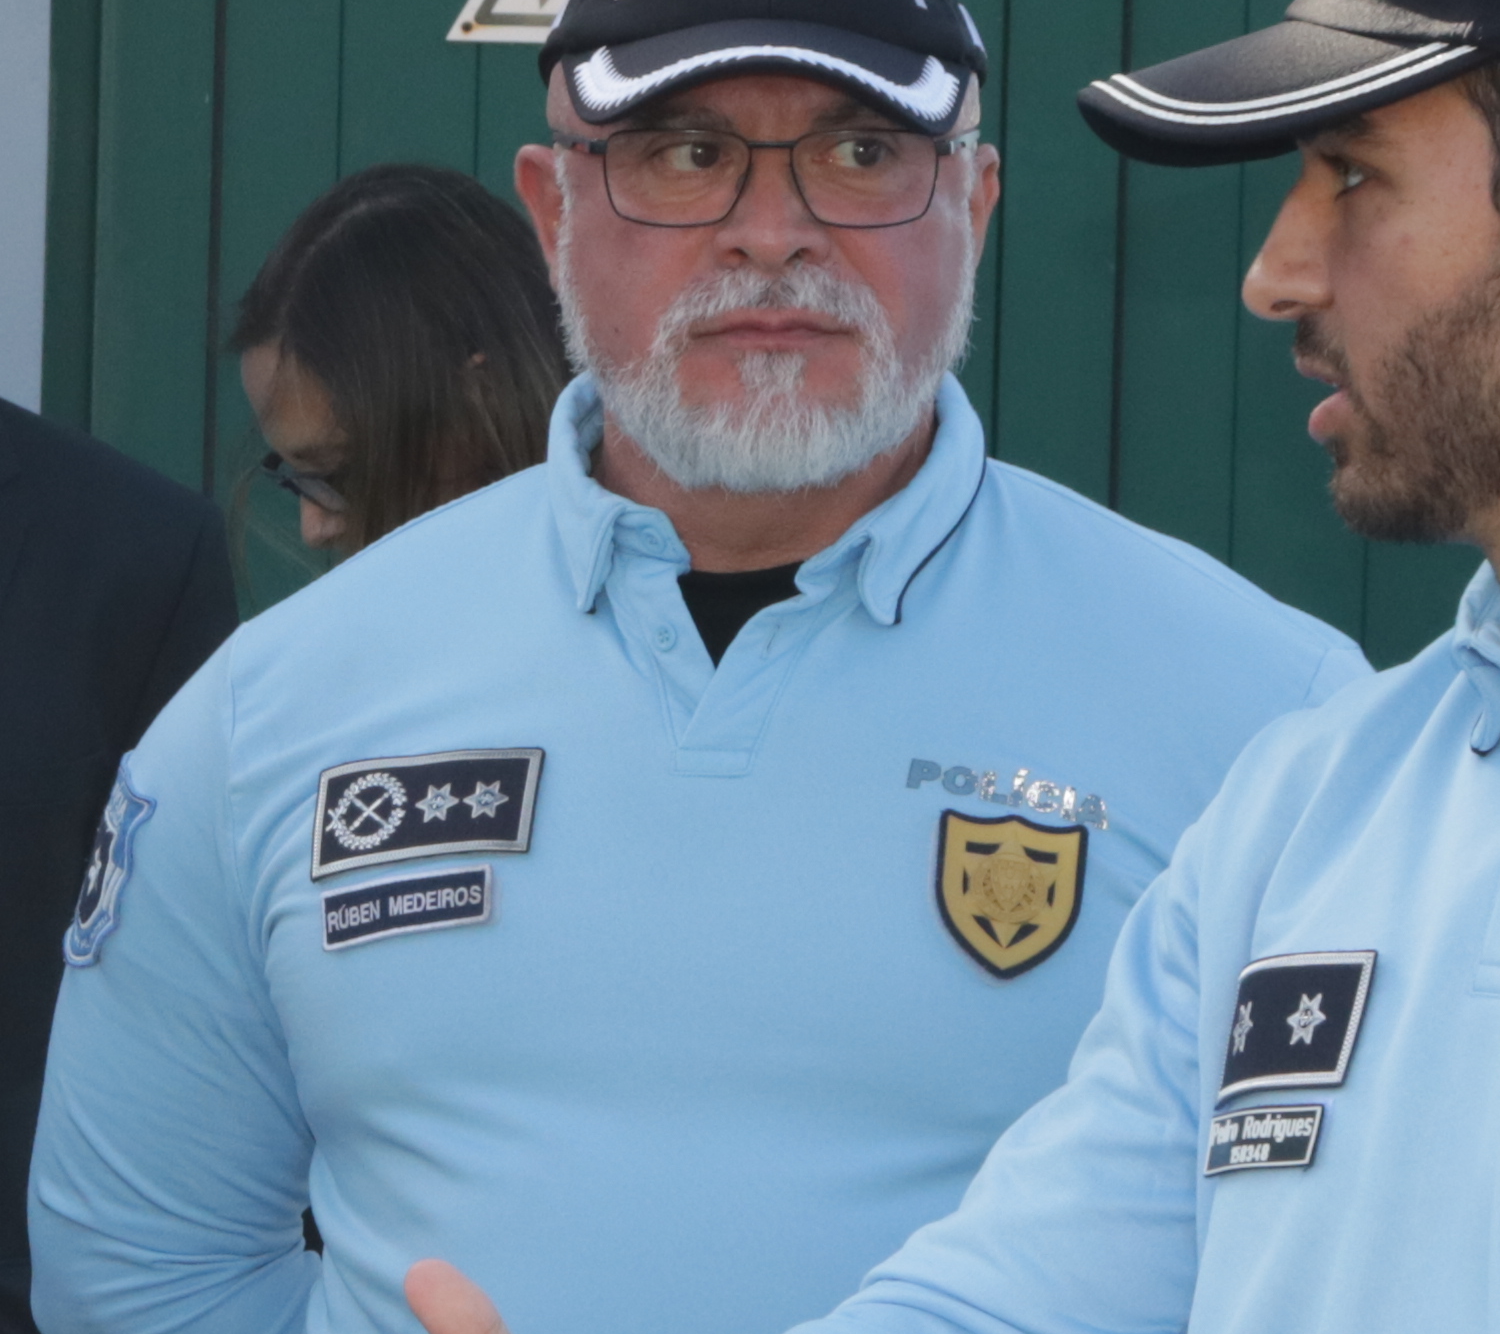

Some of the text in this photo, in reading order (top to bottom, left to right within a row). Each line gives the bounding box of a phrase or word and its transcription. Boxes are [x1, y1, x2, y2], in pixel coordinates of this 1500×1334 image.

[906, 758, 1109, 830] POLÍCIA
[326, 884, 482, 933] RÚBEN MEDEIROS
[1242, 1113, 1314, 1143] Rodrigues
